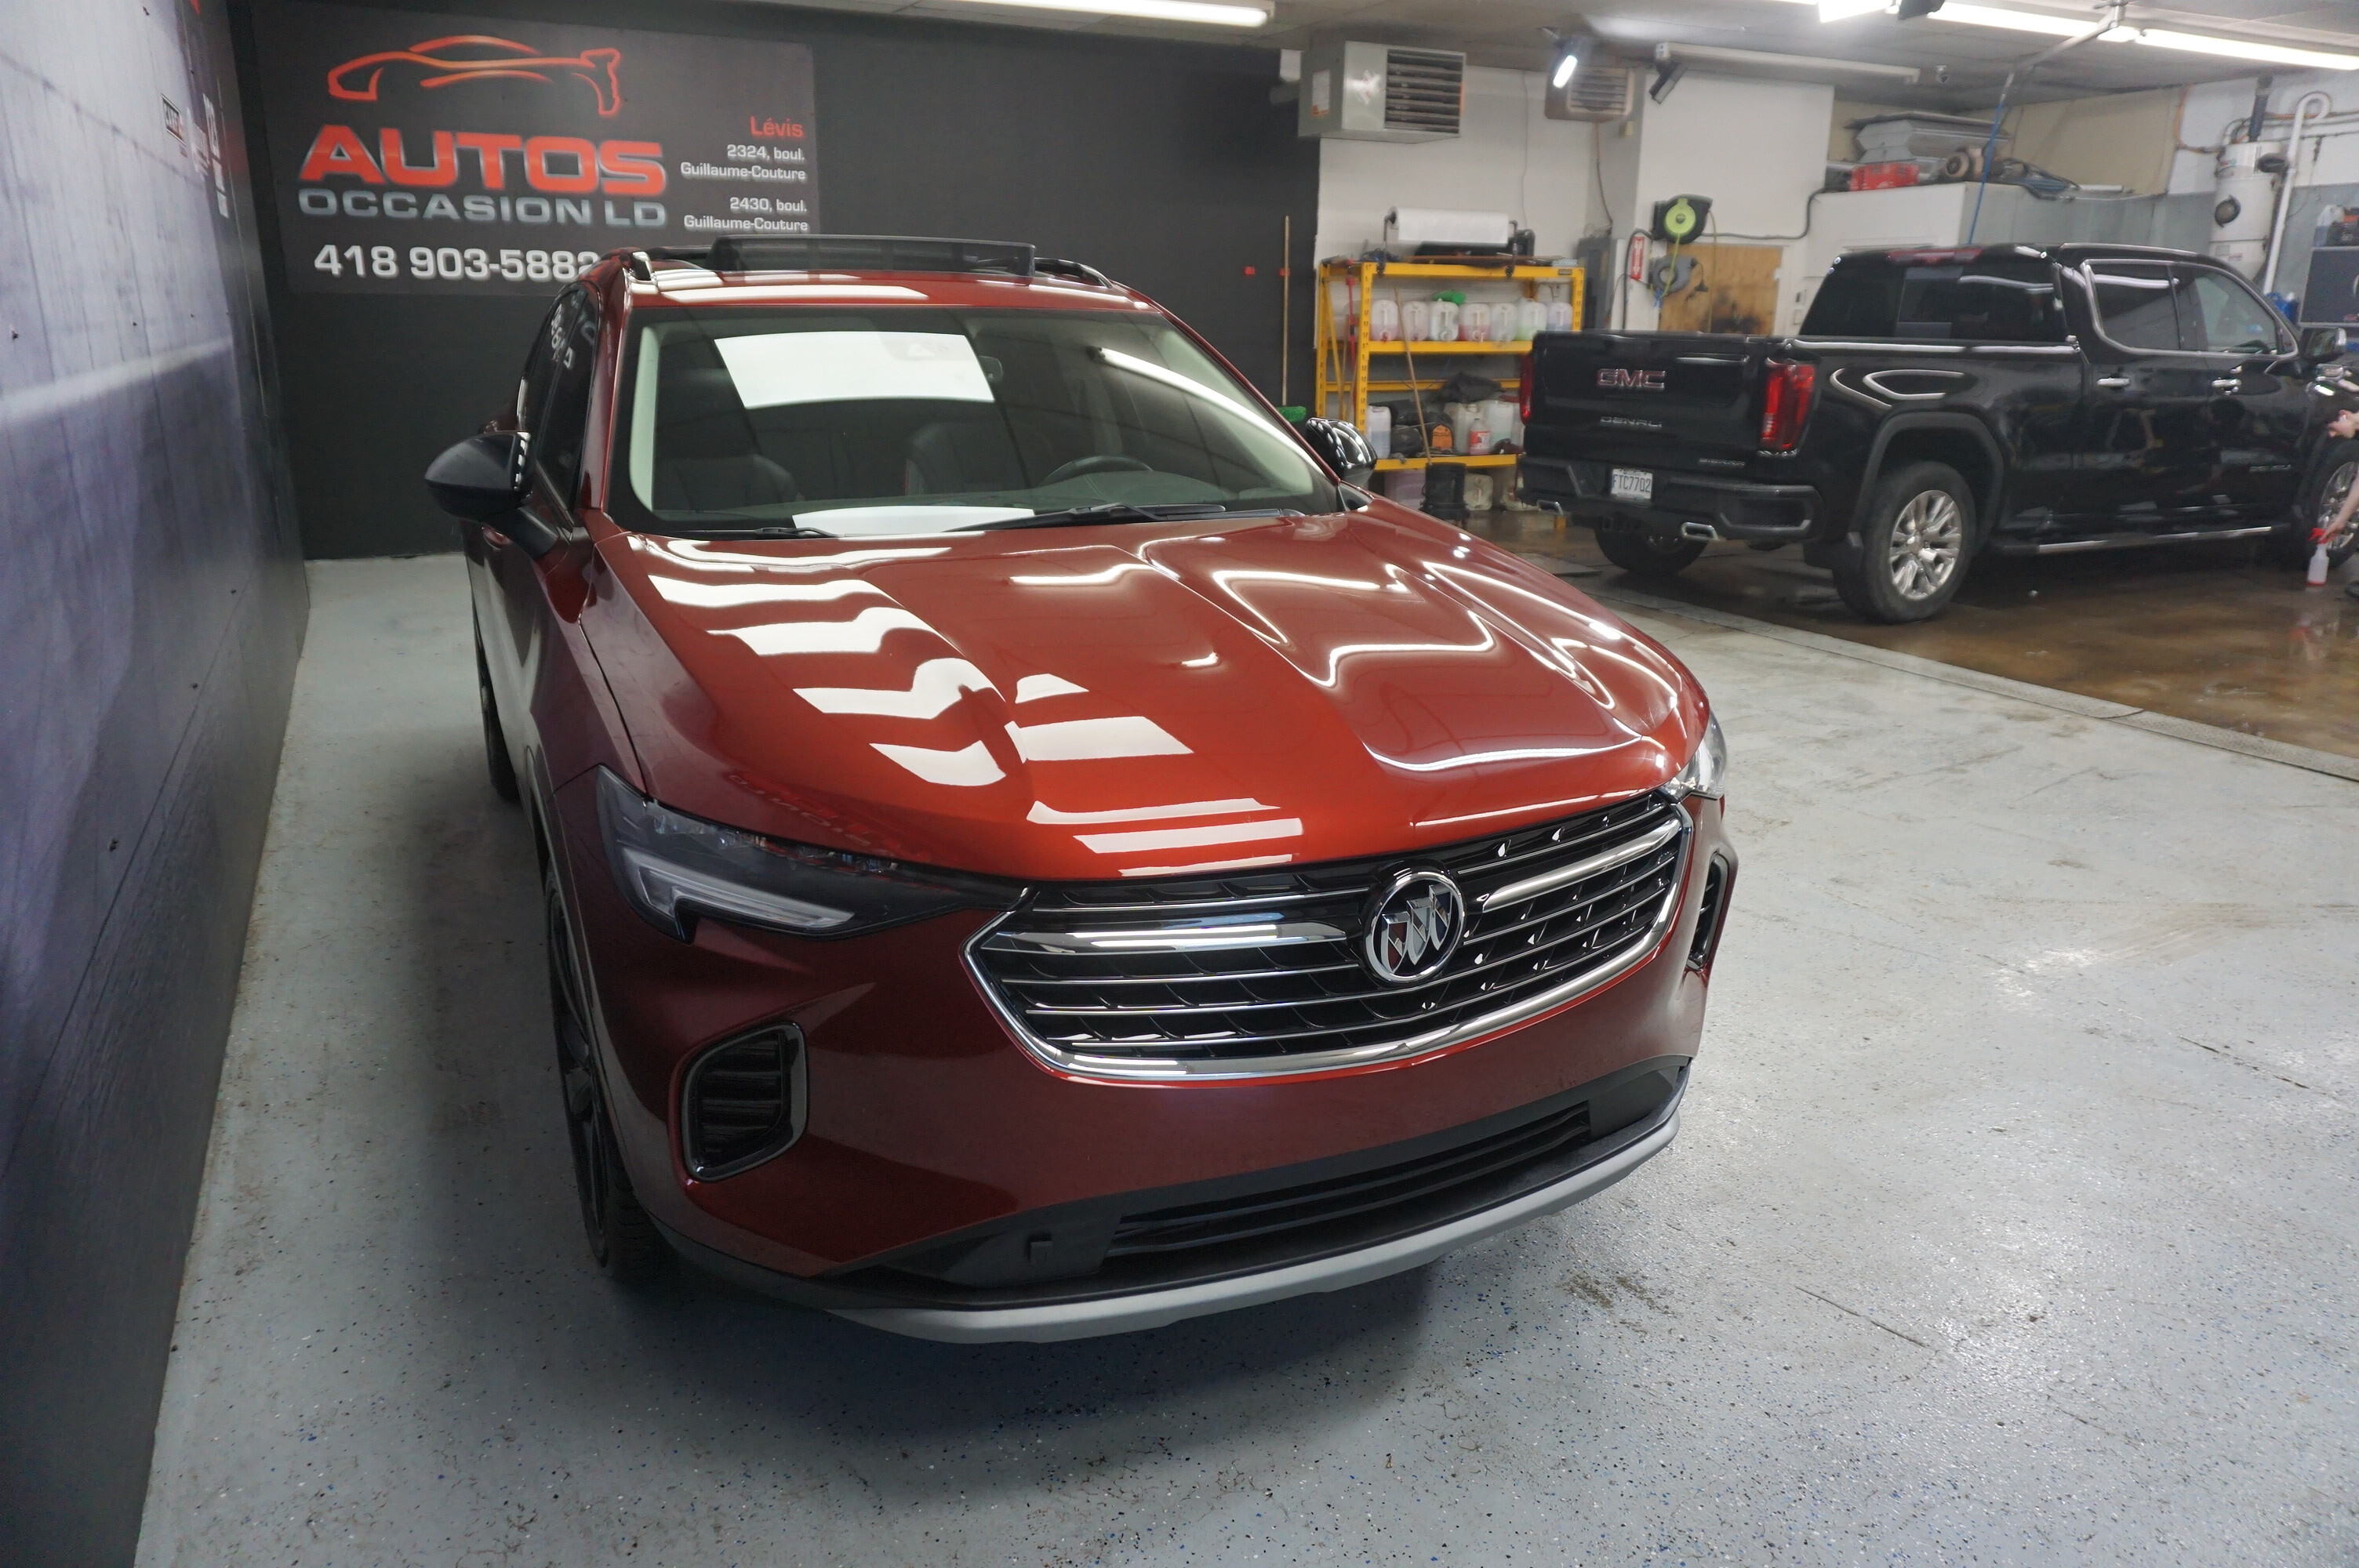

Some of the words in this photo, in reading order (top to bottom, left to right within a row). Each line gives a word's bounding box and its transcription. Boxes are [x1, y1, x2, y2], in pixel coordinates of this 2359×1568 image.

[749, 116, 804, 137] Lévis
[299, 124, 667, 194] AUTOS
[727, 143, 770, 161] 2324,
[774, 147, 805, 161] boul.
[680, 162, 806, 180] Guillaume-Couture
[298, 187, 591, 224] OCCASION
[604, 200, 666, 227] LD
[729, 197, 772, 212] 2430,
[776, 198, 807, 212] boul.
[684, 214, 809, 230] Guillaume-Couture
[314, 244, 398, 277] 418
[1596, 368, 1666, 389] GMC
[1612, 474, 1652, 492] FTC7702
